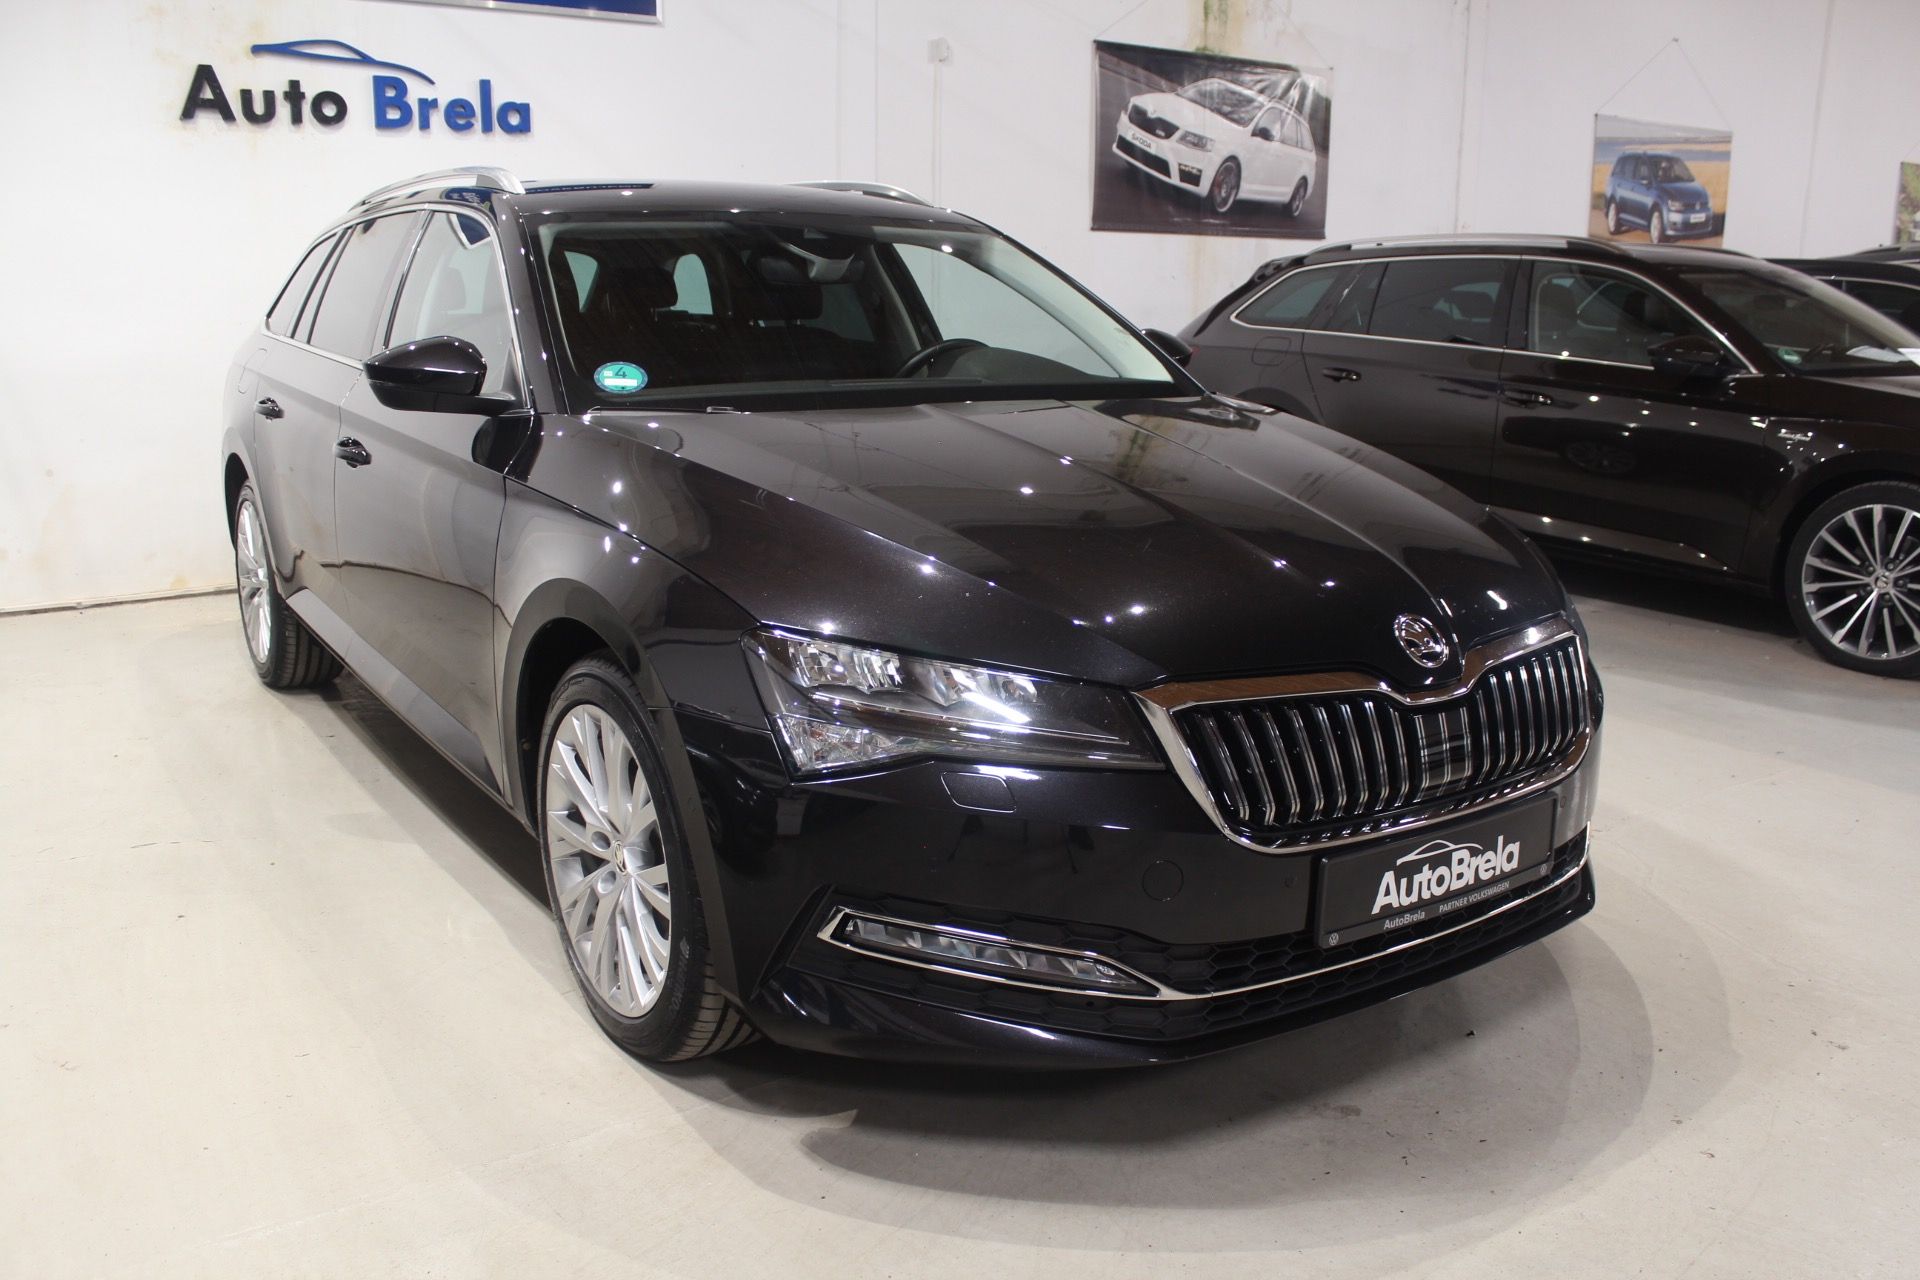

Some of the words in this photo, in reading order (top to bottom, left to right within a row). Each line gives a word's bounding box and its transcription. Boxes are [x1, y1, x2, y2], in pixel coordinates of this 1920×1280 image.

[179, 63, 348, 125] Auto
[372, 74, 531, 134] Brela
[614, 366, 627, 378] 4
[1371, 834, 1520, 915] AutoBrela
[1383, 910, 1426, 930] AutoBrela
[1439, 897, 1469, 913] PARTNER
[1468, 880, 1510, 903] VOLKSWAGEN
